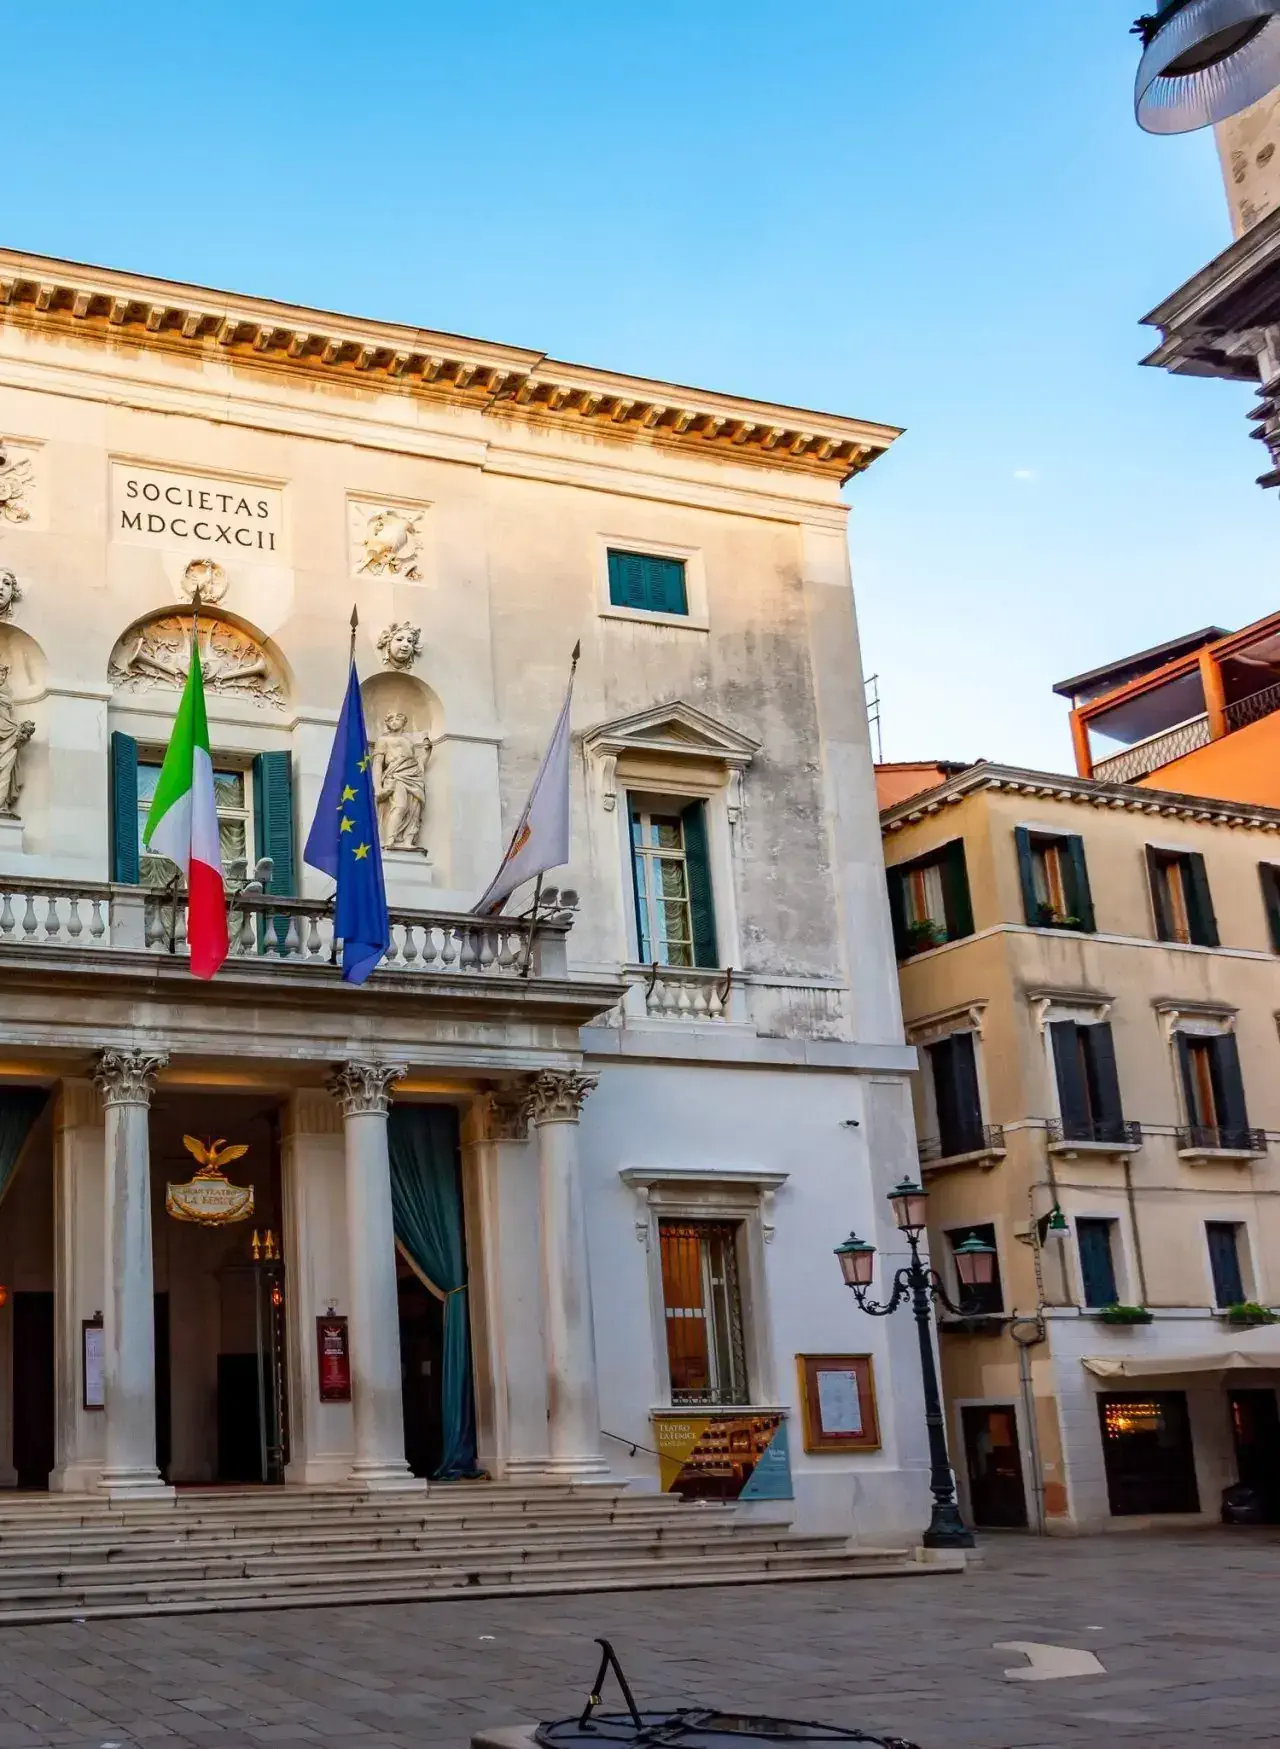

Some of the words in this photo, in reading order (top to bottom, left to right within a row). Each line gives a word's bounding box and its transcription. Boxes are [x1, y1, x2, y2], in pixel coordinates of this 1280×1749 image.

[126, 480, 269, 519] SOCIETAS
[120, 510, 276, 551] MDCCXCII
[658, 1423, 691, 1432] TEATRO
